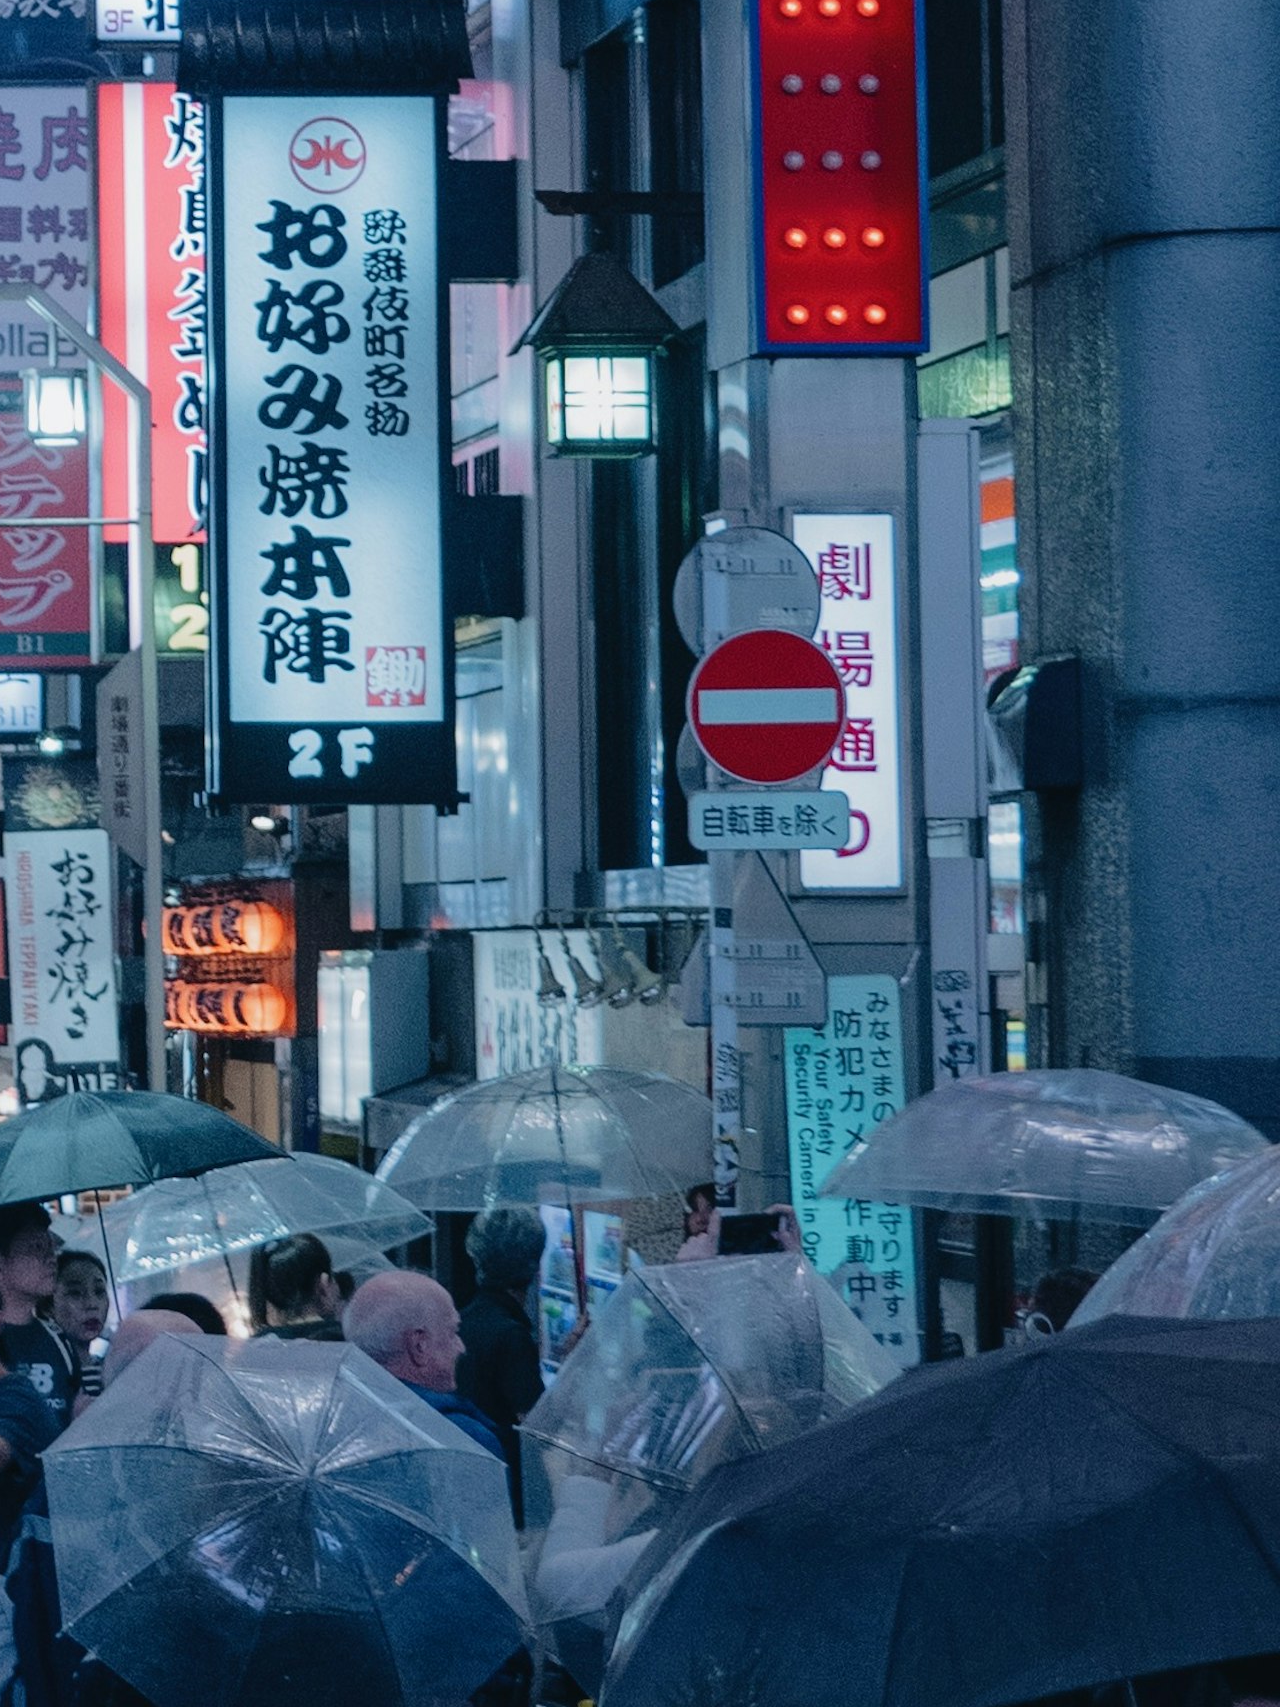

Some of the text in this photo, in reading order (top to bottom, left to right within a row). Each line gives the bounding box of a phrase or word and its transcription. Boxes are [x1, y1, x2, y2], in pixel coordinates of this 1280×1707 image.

[104, 10, 135, 33] 3F
[362, 209, 411, 438] 歌舞伎町名物
[255, 200, 357, 686] お好み焼本陣
[287, 728, 376, 779] 2F
[702, 803, 837, 840] 自転車を除く
[792, 1043, 813, 1122] Security
[814, 1098, 834, 1157] Safety
[797, 1127, 816, 1202] Camera
